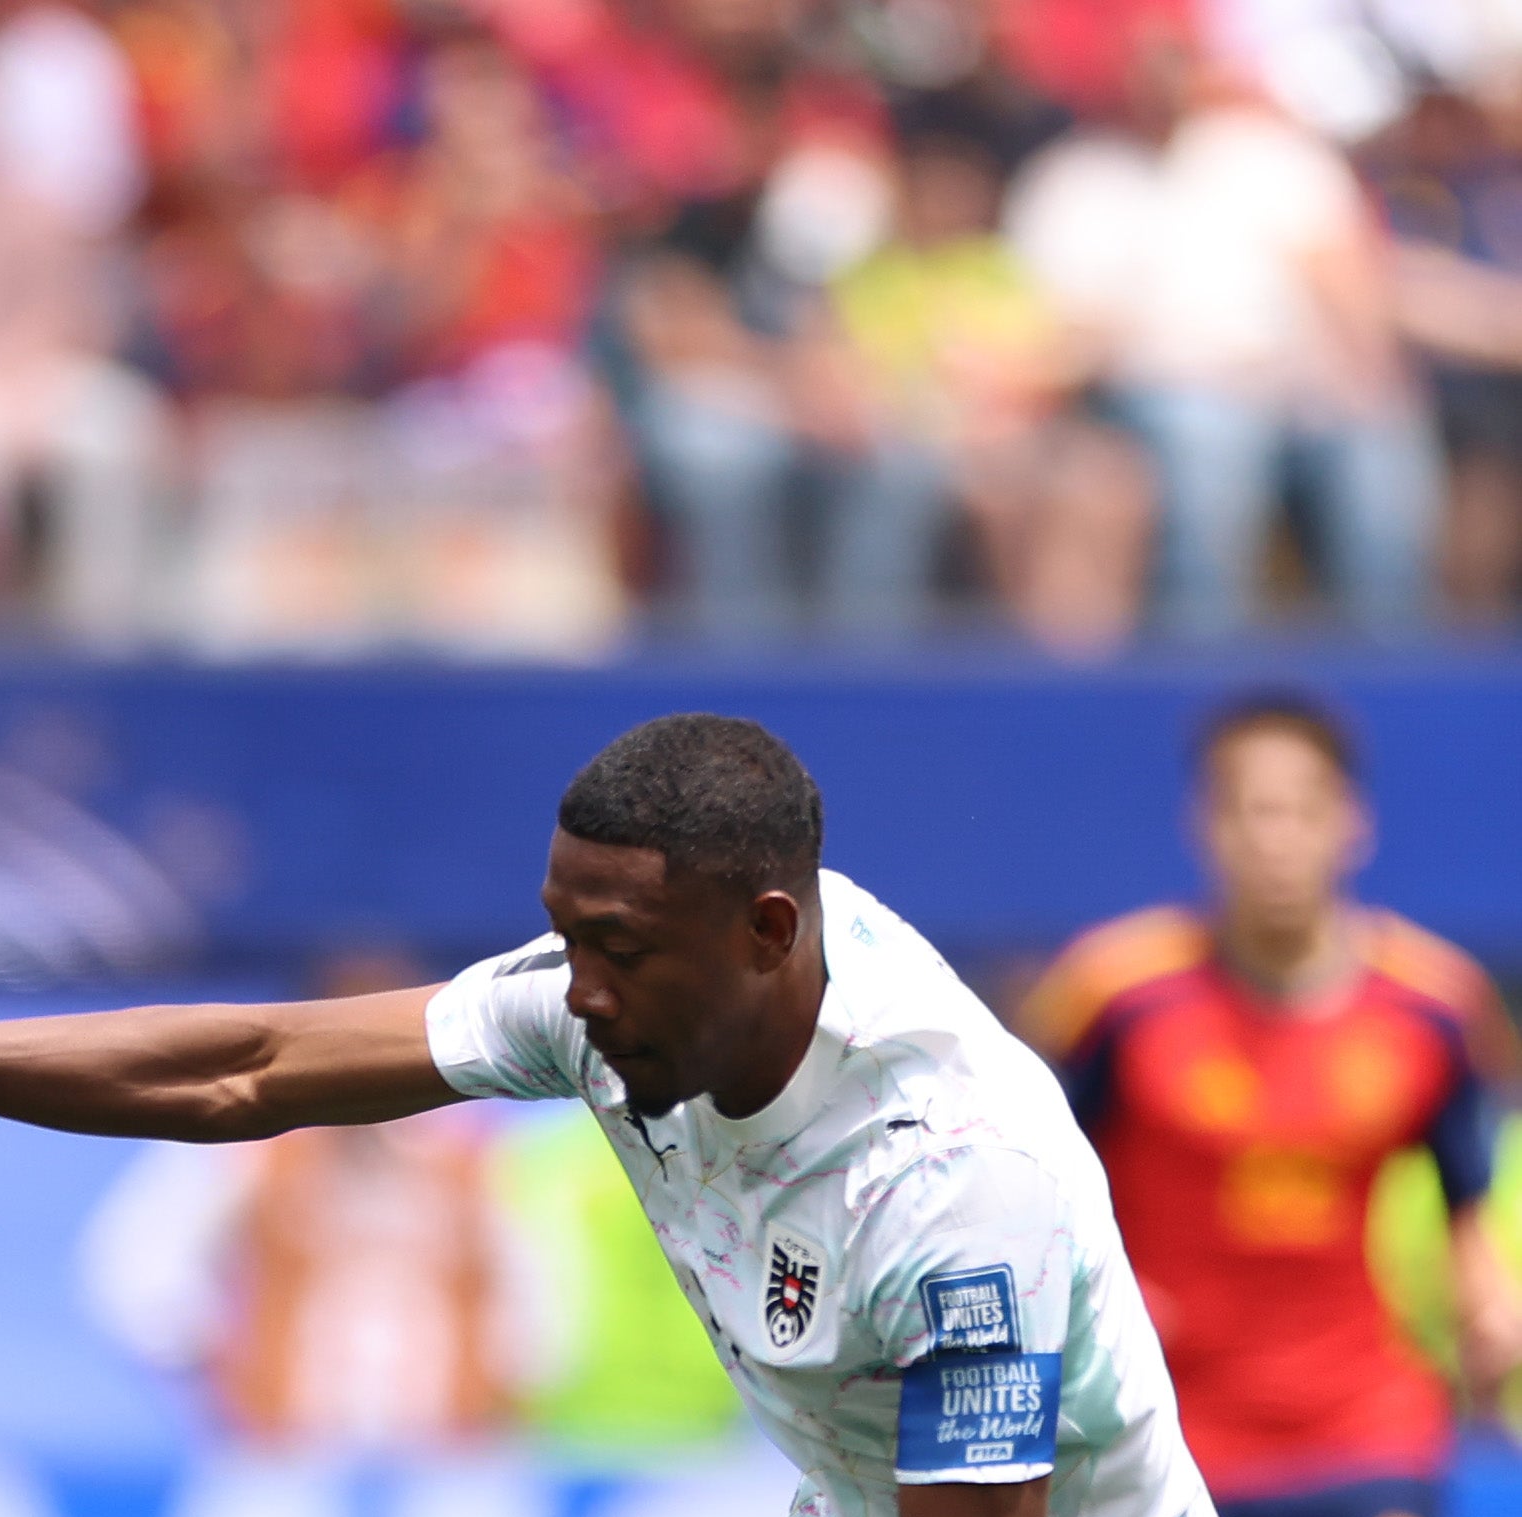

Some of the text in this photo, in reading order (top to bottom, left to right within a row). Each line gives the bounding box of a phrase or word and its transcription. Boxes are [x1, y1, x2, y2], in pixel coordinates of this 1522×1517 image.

[938, 1282, 1001, 1308] FOOTBALL
[941, 1300, 1004, 1331] UNITES
[940, 1361, 1042, 1388] FOOTBALL
[941, 1383, 1042, 1417] UNITES
[937, 1411, 1046, 1443] the World
[968, 1444, 1012, 1462] FIFA
